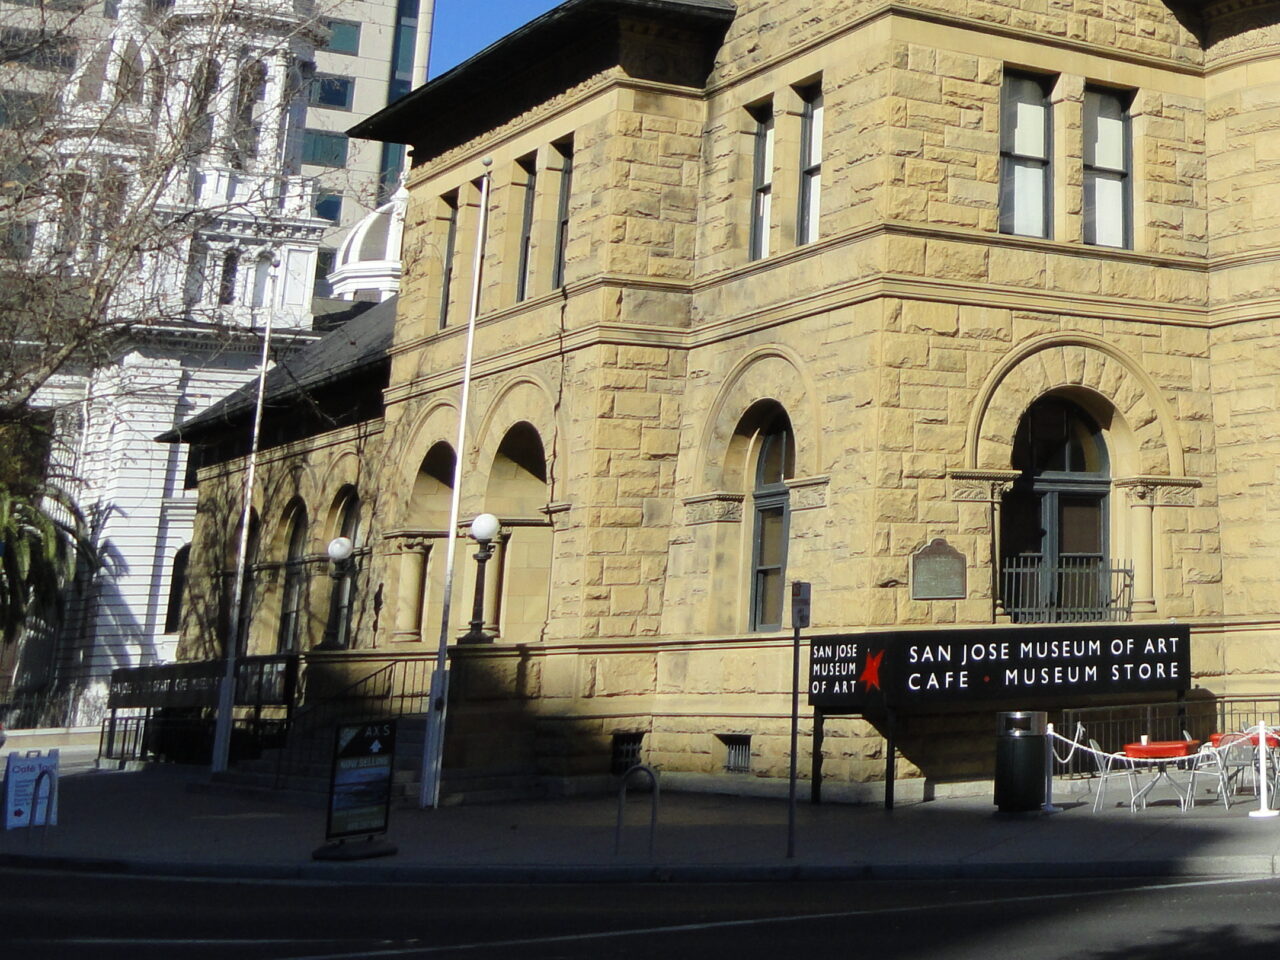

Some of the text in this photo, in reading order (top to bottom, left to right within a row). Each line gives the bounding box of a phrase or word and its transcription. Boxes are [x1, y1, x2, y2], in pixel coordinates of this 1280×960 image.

[813, 643, 857, 659] SAN JOSE
[910, 637, 1180, 665] SAN JOSE MUSEUM OF ART
[812, 662, 857, 676] MUSEUM
[908, 662, 1179, 690] CAFE MUSEUM STORE
[812, 680, 857, 694] OF ART
